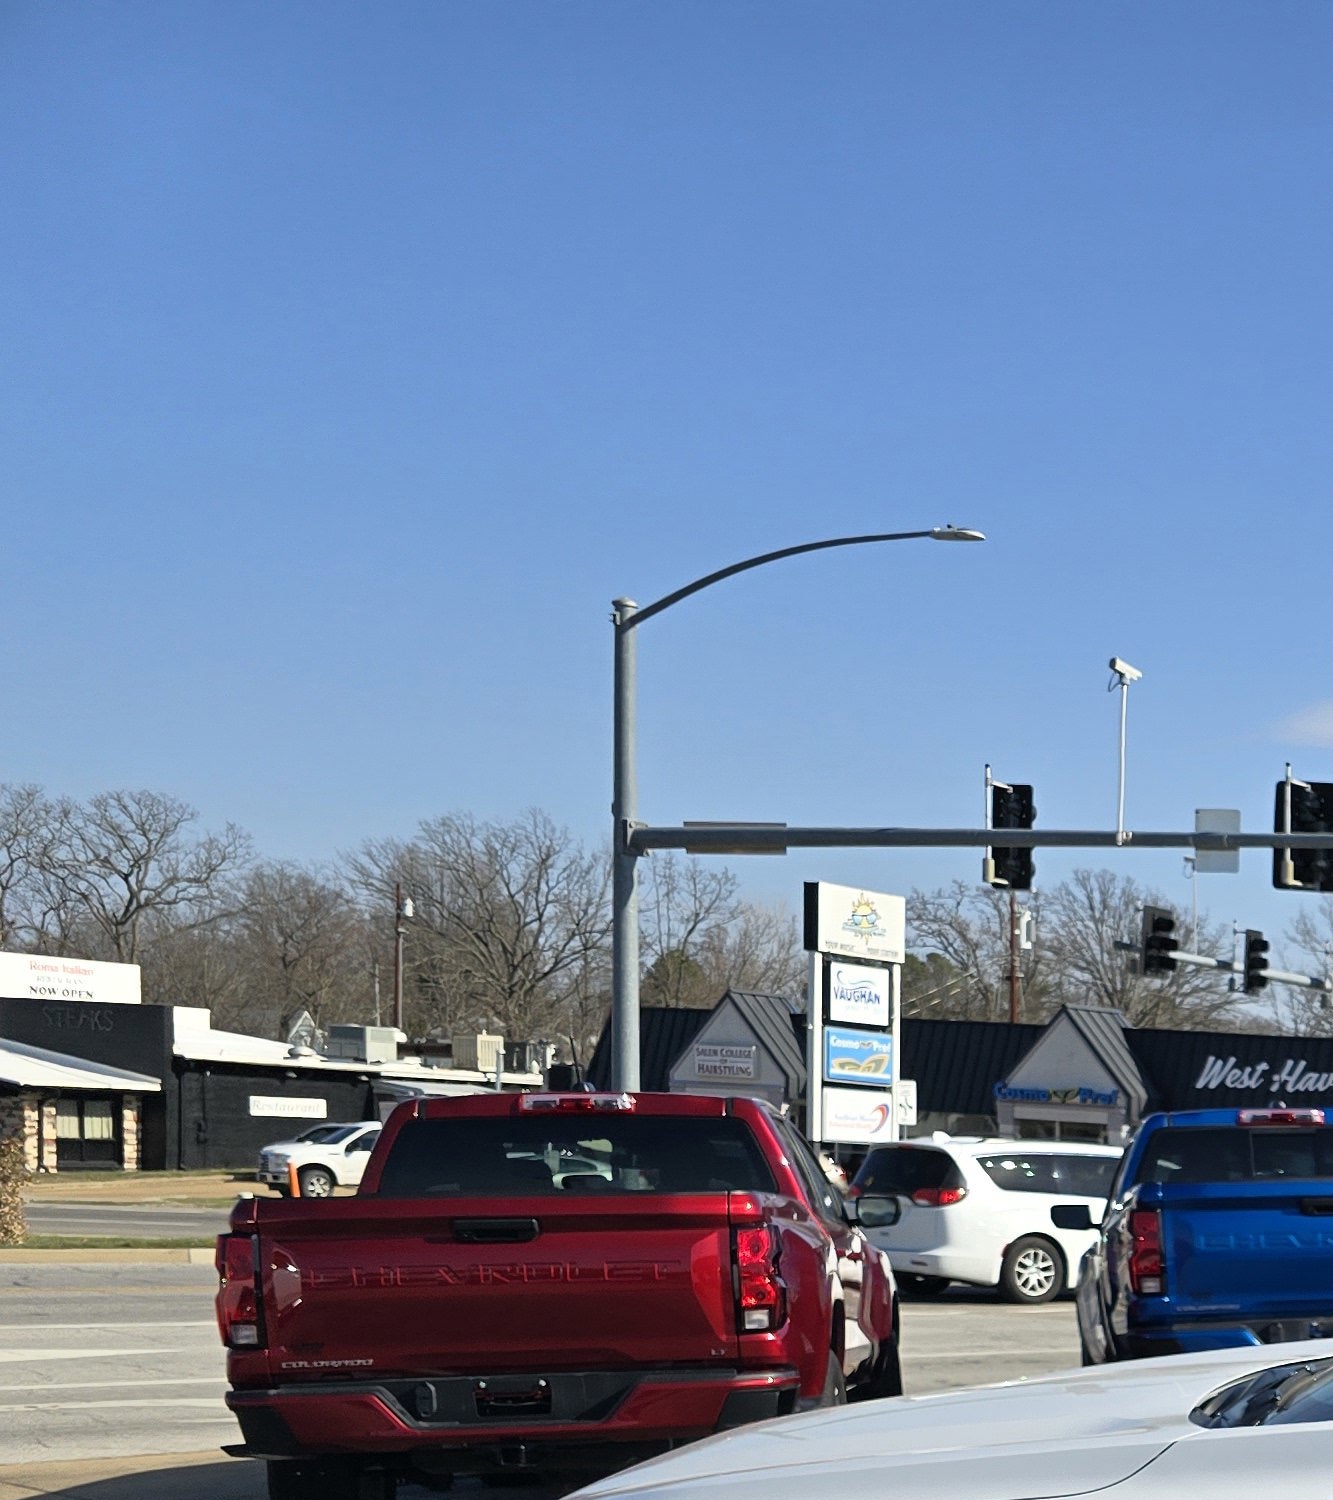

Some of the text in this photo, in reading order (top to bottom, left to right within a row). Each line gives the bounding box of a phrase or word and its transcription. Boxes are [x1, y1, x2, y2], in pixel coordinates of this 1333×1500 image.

[29, 985, 94, 999] NOW OPEN
[833, 986, 880, 1004] VAUGHAN
[830, 1035, 861, 1050] Cosmo
[697, 1063, 753, 1077] HAIRSTYLING
[1195, 1055, 1270, 1090] West
[993, 1081, 1118, 1105] Cosmo Prof
[304, 1260, 682, 1289] CHEVROLET
[282, 1359, 374, 1369] COLORADO
